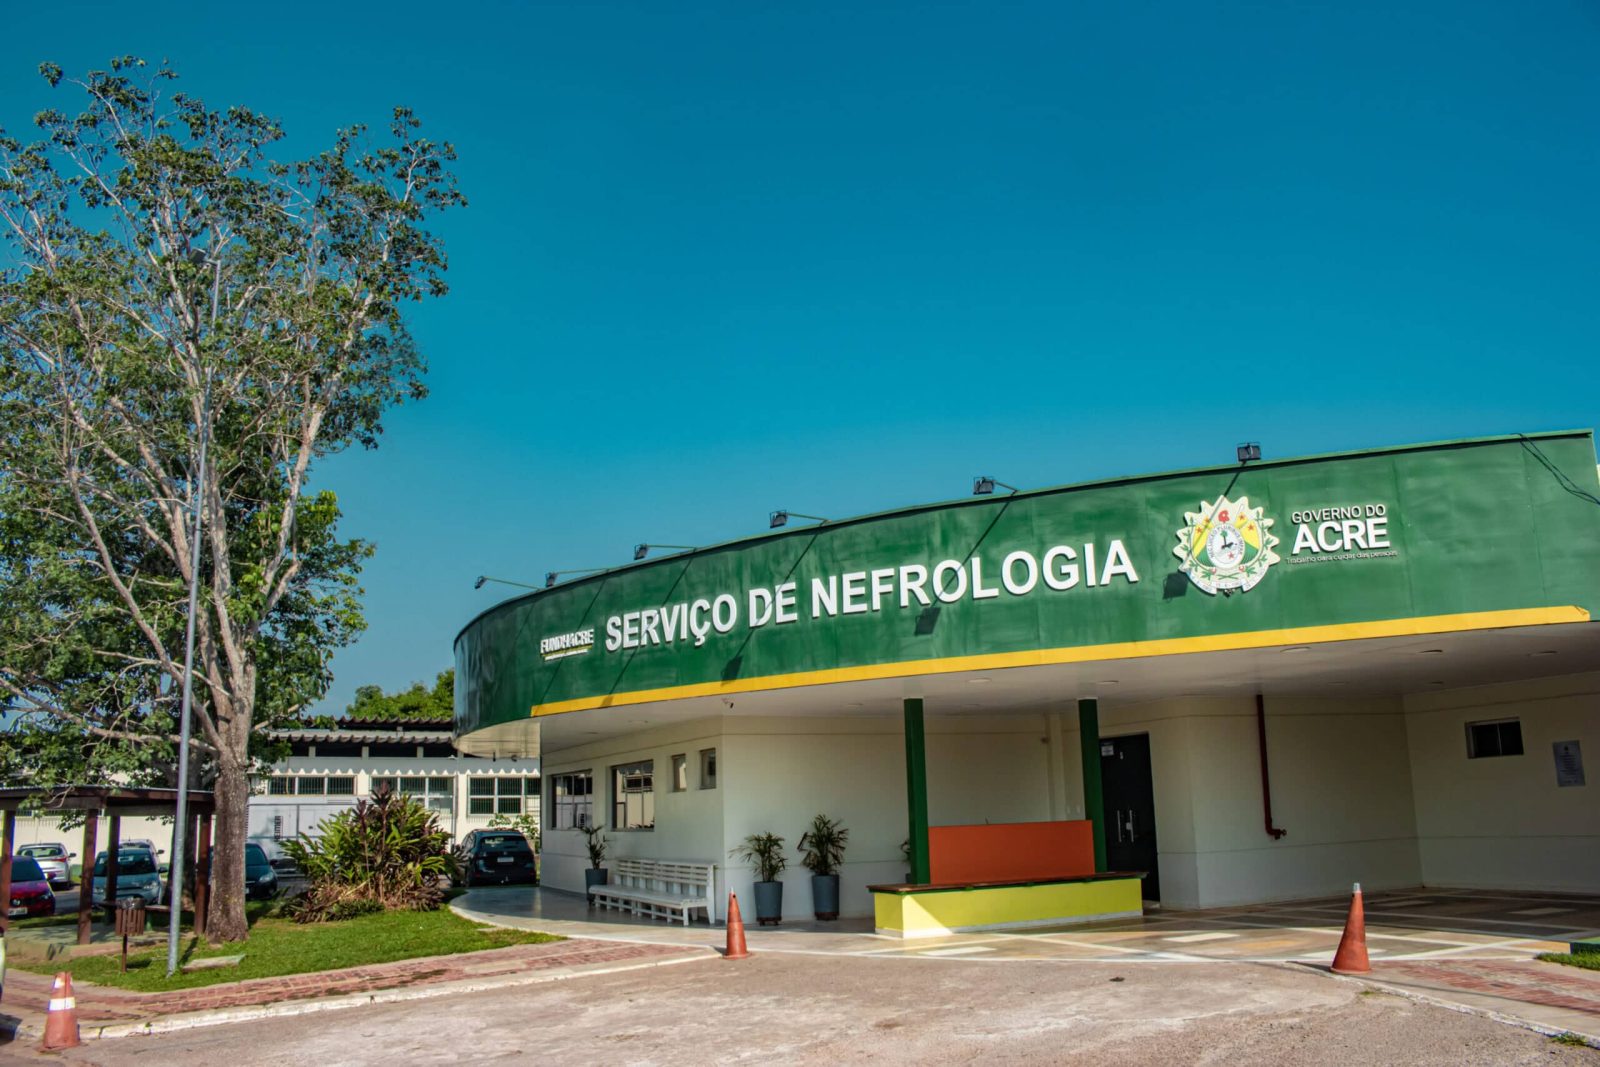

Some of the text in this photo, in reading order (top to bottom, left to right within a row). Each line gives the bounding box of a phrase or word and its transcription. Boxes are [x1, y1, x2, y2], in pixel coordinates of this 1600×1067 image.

[1292, 504, 1386, 524] GOVERNO DO
[1292, 517, 1391, 555] ACRE
[605, 594, 738, 651] SERVIÇO
[749, 582, 798, 628] DE
[811, 539, 1140, 618] NEFROLOGIA
